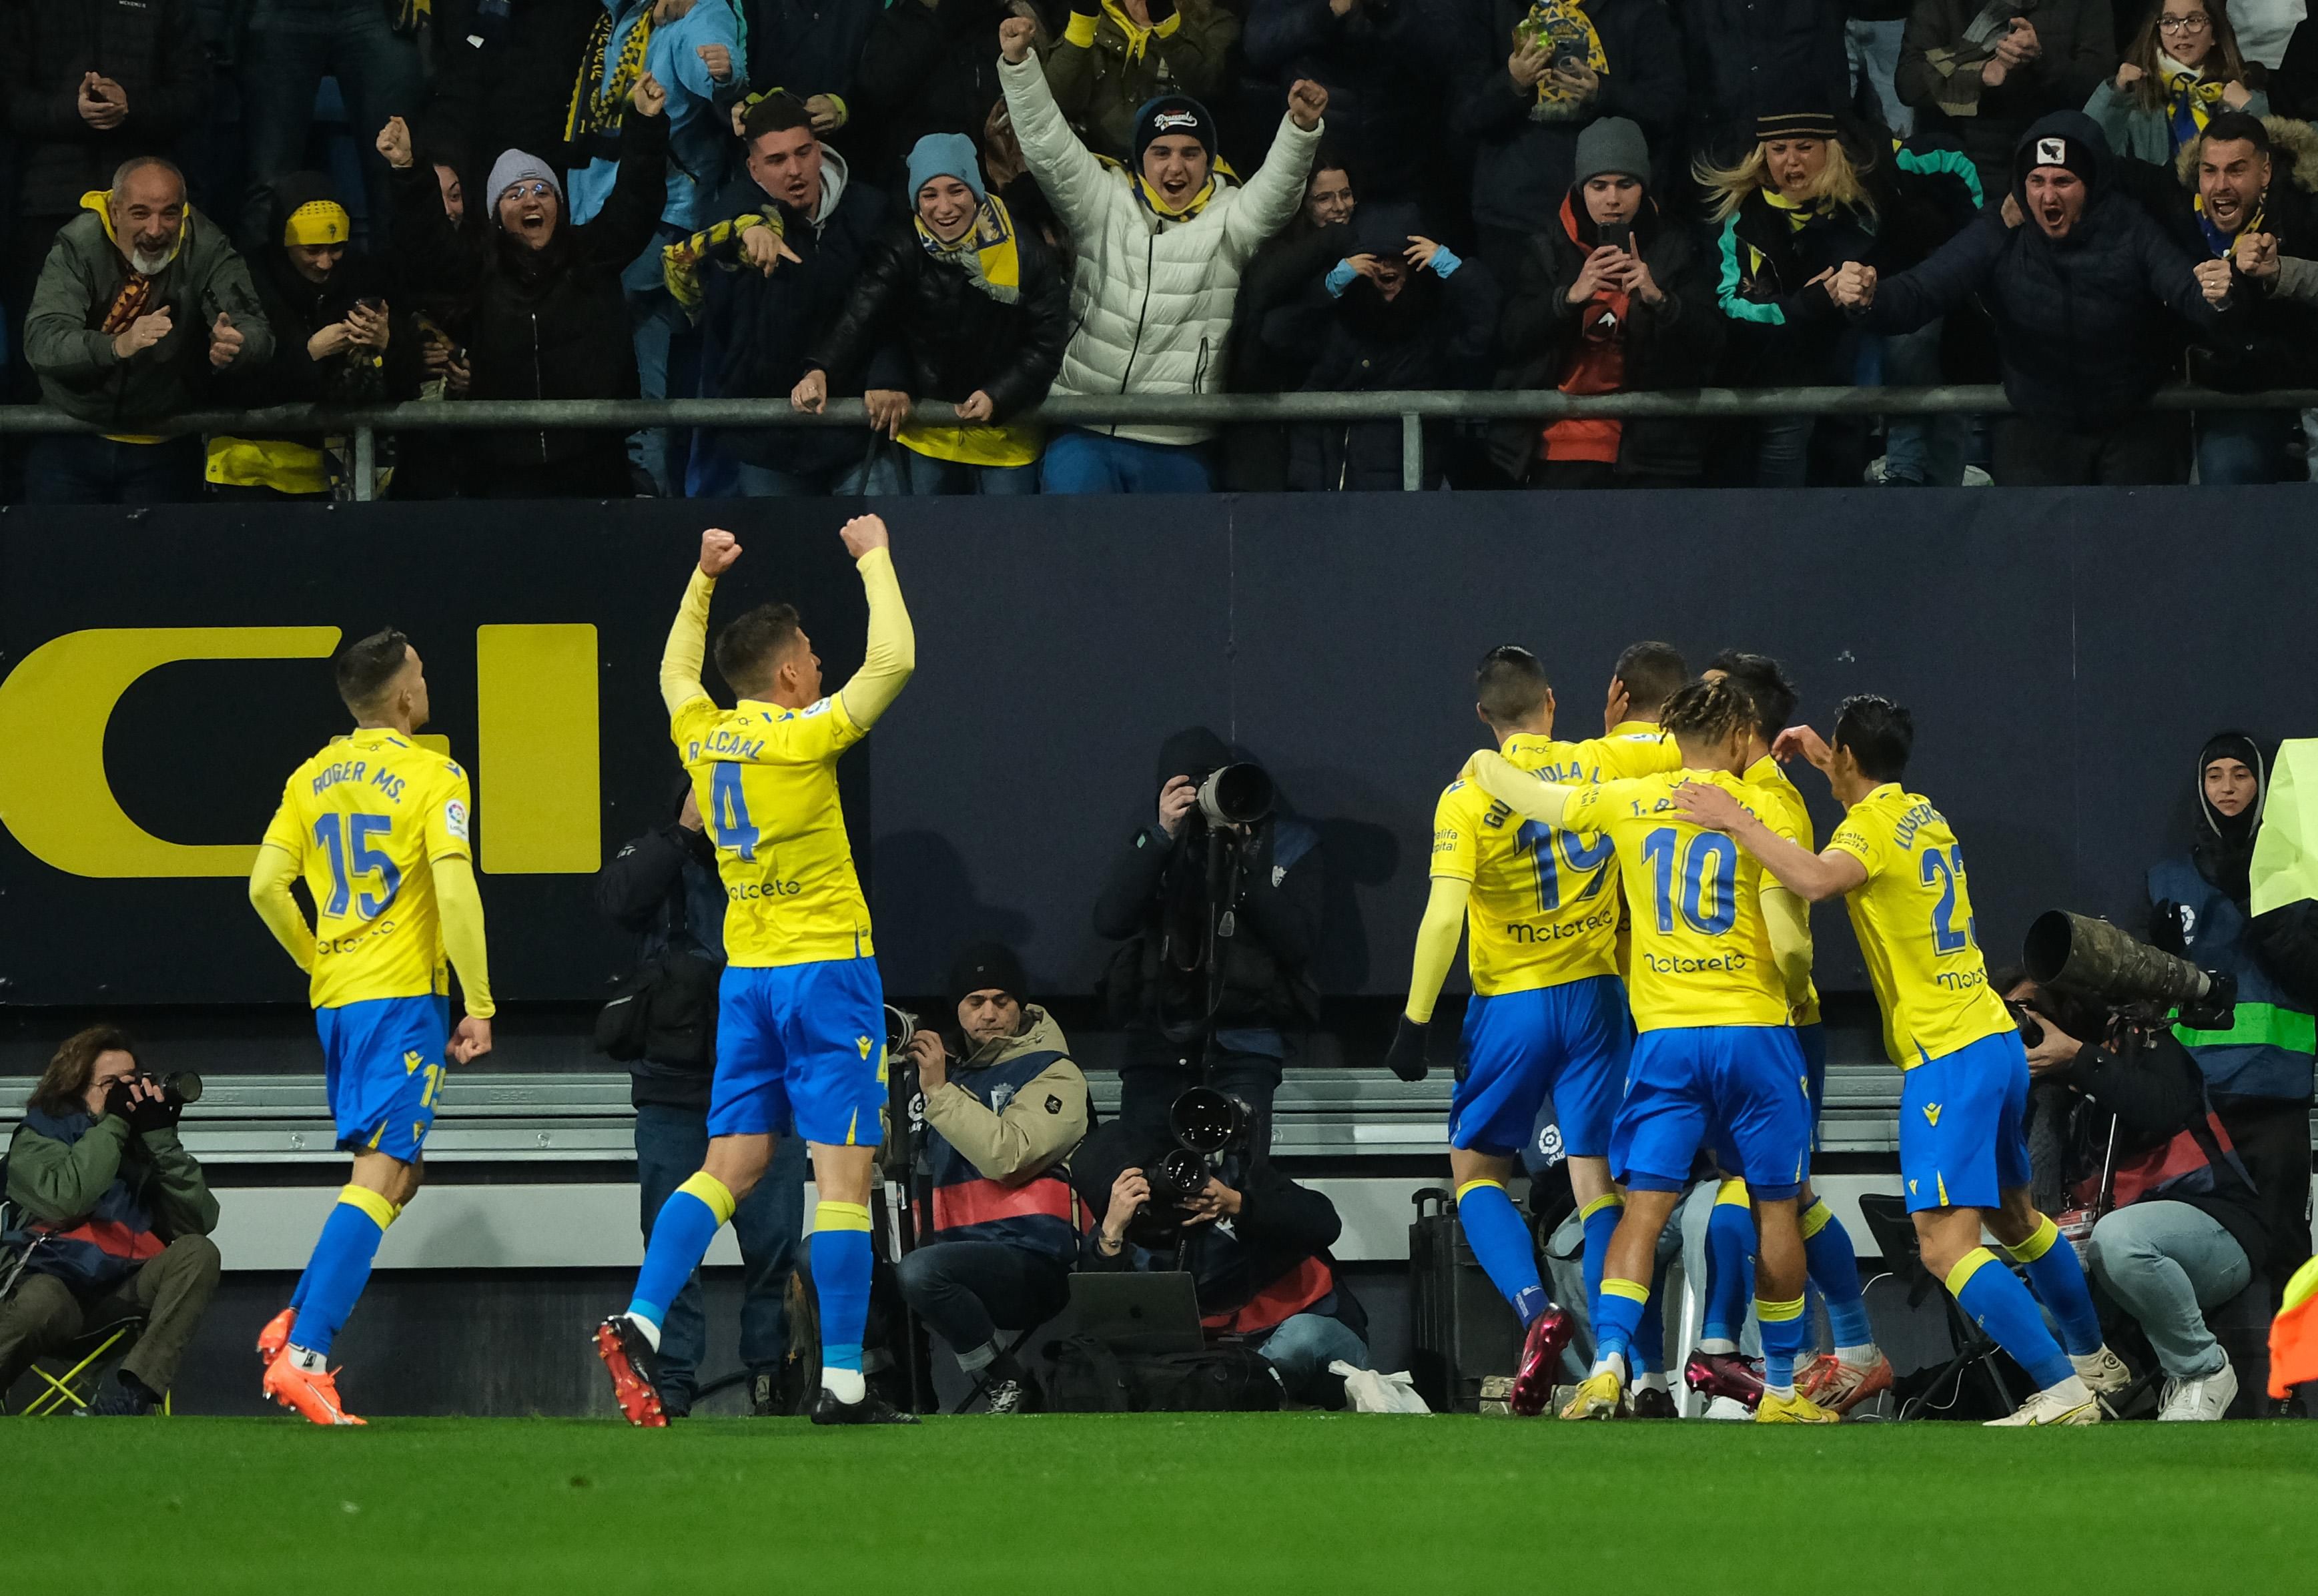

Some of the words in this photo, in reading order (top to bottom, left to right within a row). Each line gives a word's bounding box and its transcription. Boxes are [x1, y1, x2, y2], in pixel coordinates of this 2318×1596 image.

[312, 761, 366, 796] ROGER
[371, 767, 406, 804] MS.
[710, 761, 761, 864] 4
[1483, 761, 1583, 830] GUIOLA
[313, 812, 403, 922] 15
[1435, 828, 1458, 839] alifa
[1513, 819, 1616, 914] 19
[1641, 827, 1737, 937] 10
